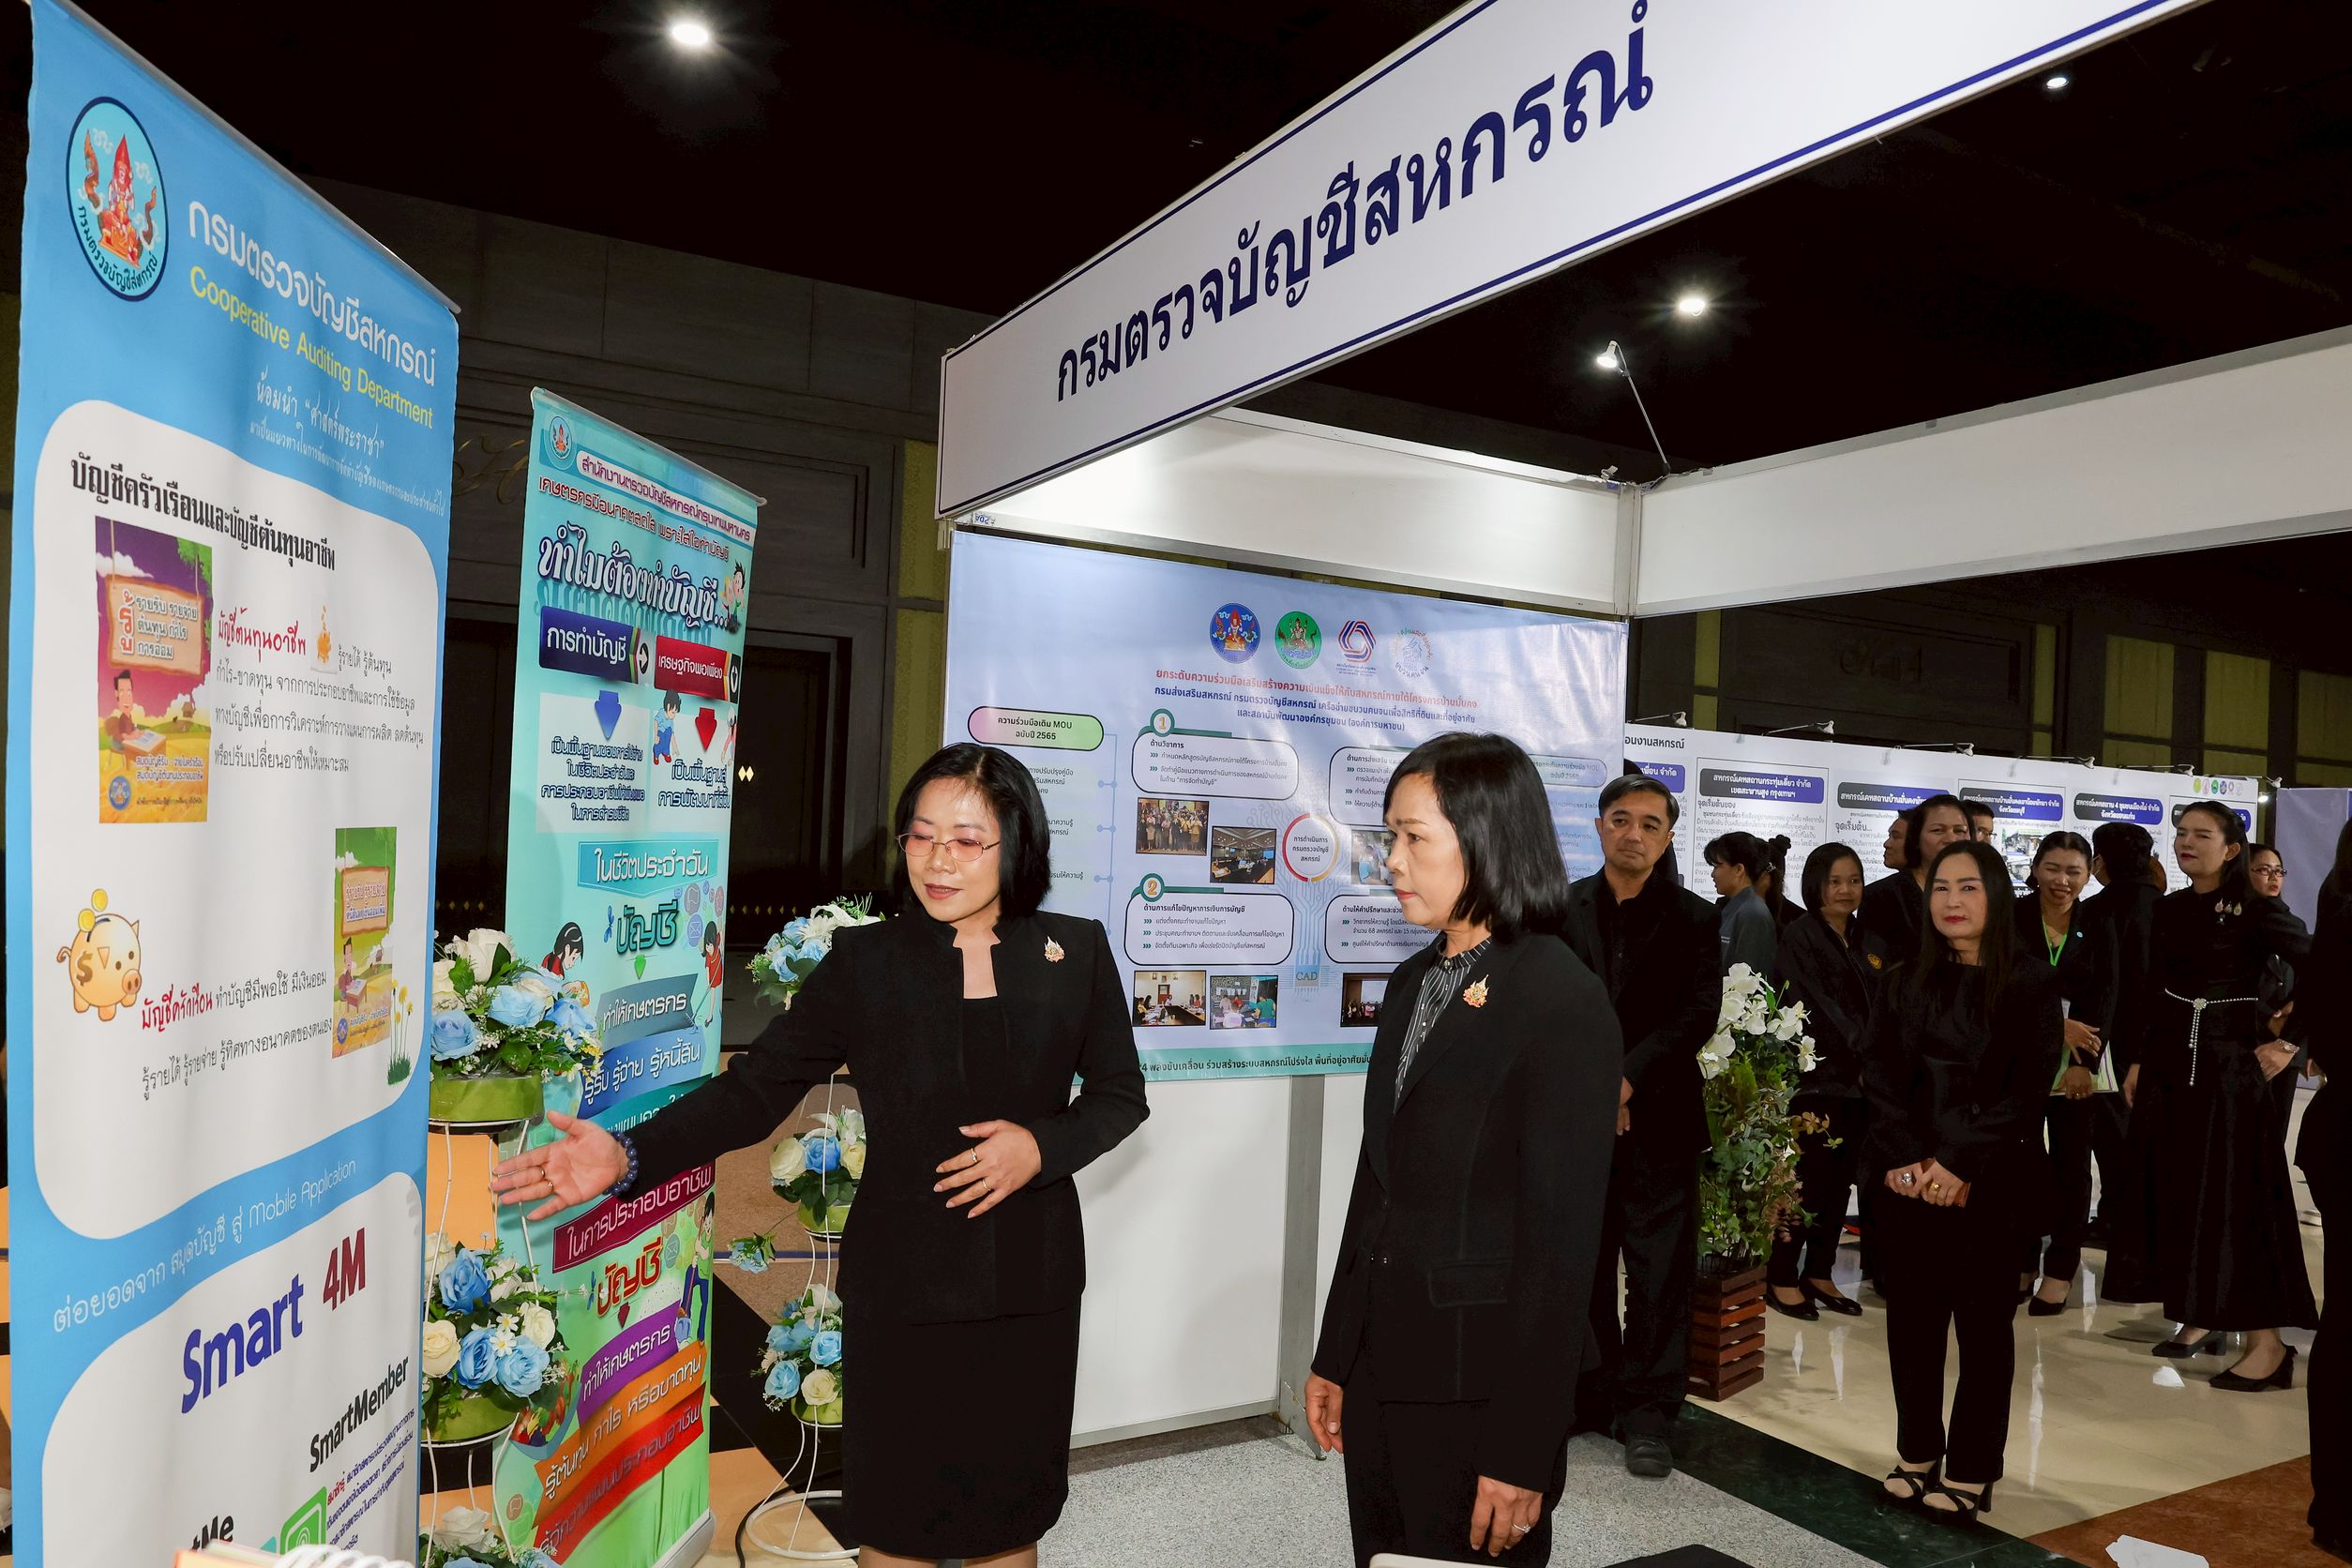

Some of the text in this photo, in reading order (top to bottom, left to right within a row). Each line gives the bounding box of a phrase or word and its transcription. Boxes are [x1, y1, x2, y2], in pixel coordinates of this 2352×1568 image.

[1057, 0, 1653, 401] กรมตรวจบัญชีสหกรณ์
[189, 201, 436, 386] กรมตรวจบัญชีสหกรณ์
[190, 265, 434, 430] Cooperative Auditing Department
[256, 364, 298, 418] น้อมนำ
[71, 451, 336, 571] บัญชีครัวเรือนและบัญชีต้นทุนอาชีพ
[539, 475, 656, 535] เกษตรกรมีอนาคตสดใส
[581, 456, 751, 542] สำนักงานตรวจบัญชีสหกรณ์กรุงเทพมหานคร
[136, 596, 167, 613] รายรับ
[138, 614, 167, 641] ต้นทุน
[138, 642, 173, 659] การออม
[218, 607, 307, 663] บัญชีต้นทุนอาชีพ
[547, 626, 627, 665] การทำบัญชี
[658, 654, 724, 680] เศรษฐกิจพอเพียง
[998, 716, 1073, 730] ความร่วมมือเดิม MOU
[1154, 686, 1231, 701] กรมส่งเสริมสหกรณ์
[1233, 693, 1317, 709] กรมตรวจบัญชีสหกรณ์
[1158, 716, 1167, 731] 1
[1237, 708, 1347, 727] และสถาบันพัฒนาองค์กรชุมชน
[1015, 730, 1057, 741] ฉบับปี 2565
[1150, 740, 1184, 749] ด้านวิชาการ
[595, 847, 709, 882] ในชีวิตประจำวัน
[1147, 880, 1157, 896] 2
[616, 898, 679, 955] บัญชี
[1143, 903, 1245, 913] ด้านการแก้ไขปัญหาการเงินการบัญชี
[142, 969, 327, 1033] บัญชีครัวเรือน ทำบัญชีมีพอใช้ มีเงินออม
[1295, 971, 1319, 981] CAD
[602, 993, 687, 1032] ทำให้เกษตรกร
[143, 1055, 181, 1100] รู้รายได้
[183, 1047, 218, 1087] รู้รายจ่าย
[219, 1017, 332, 1071] รู้ทิศทางอนาคตของตนเอง
[612, 1056, 645, 1093] รู้จ่าย
[649, 1037, 701, 1078] รู้หนี้สิน
[1206, 1055, 1314, 1070] ร่วมสร้างระบบสหกรณ์โปร่งใส
[566, 1166, 713, 1261] ในการประกอบอาชีพ
[53, 1158, 356, 1332] ต่อยอดจาก สมุดบัญชี สู่ Mobile Application
[596, 1236, 664, 1319] บัญชี
[181, 1227, 366, 1414] Smart 4M
[583, 1324, 671, 1402] ทำให้เกษตรกร
[310, 1356, 409, 1473] SmartMember
[545, 1354, 702, 1500] รู้ต้นทุน กำไร หรือขาดทุน
